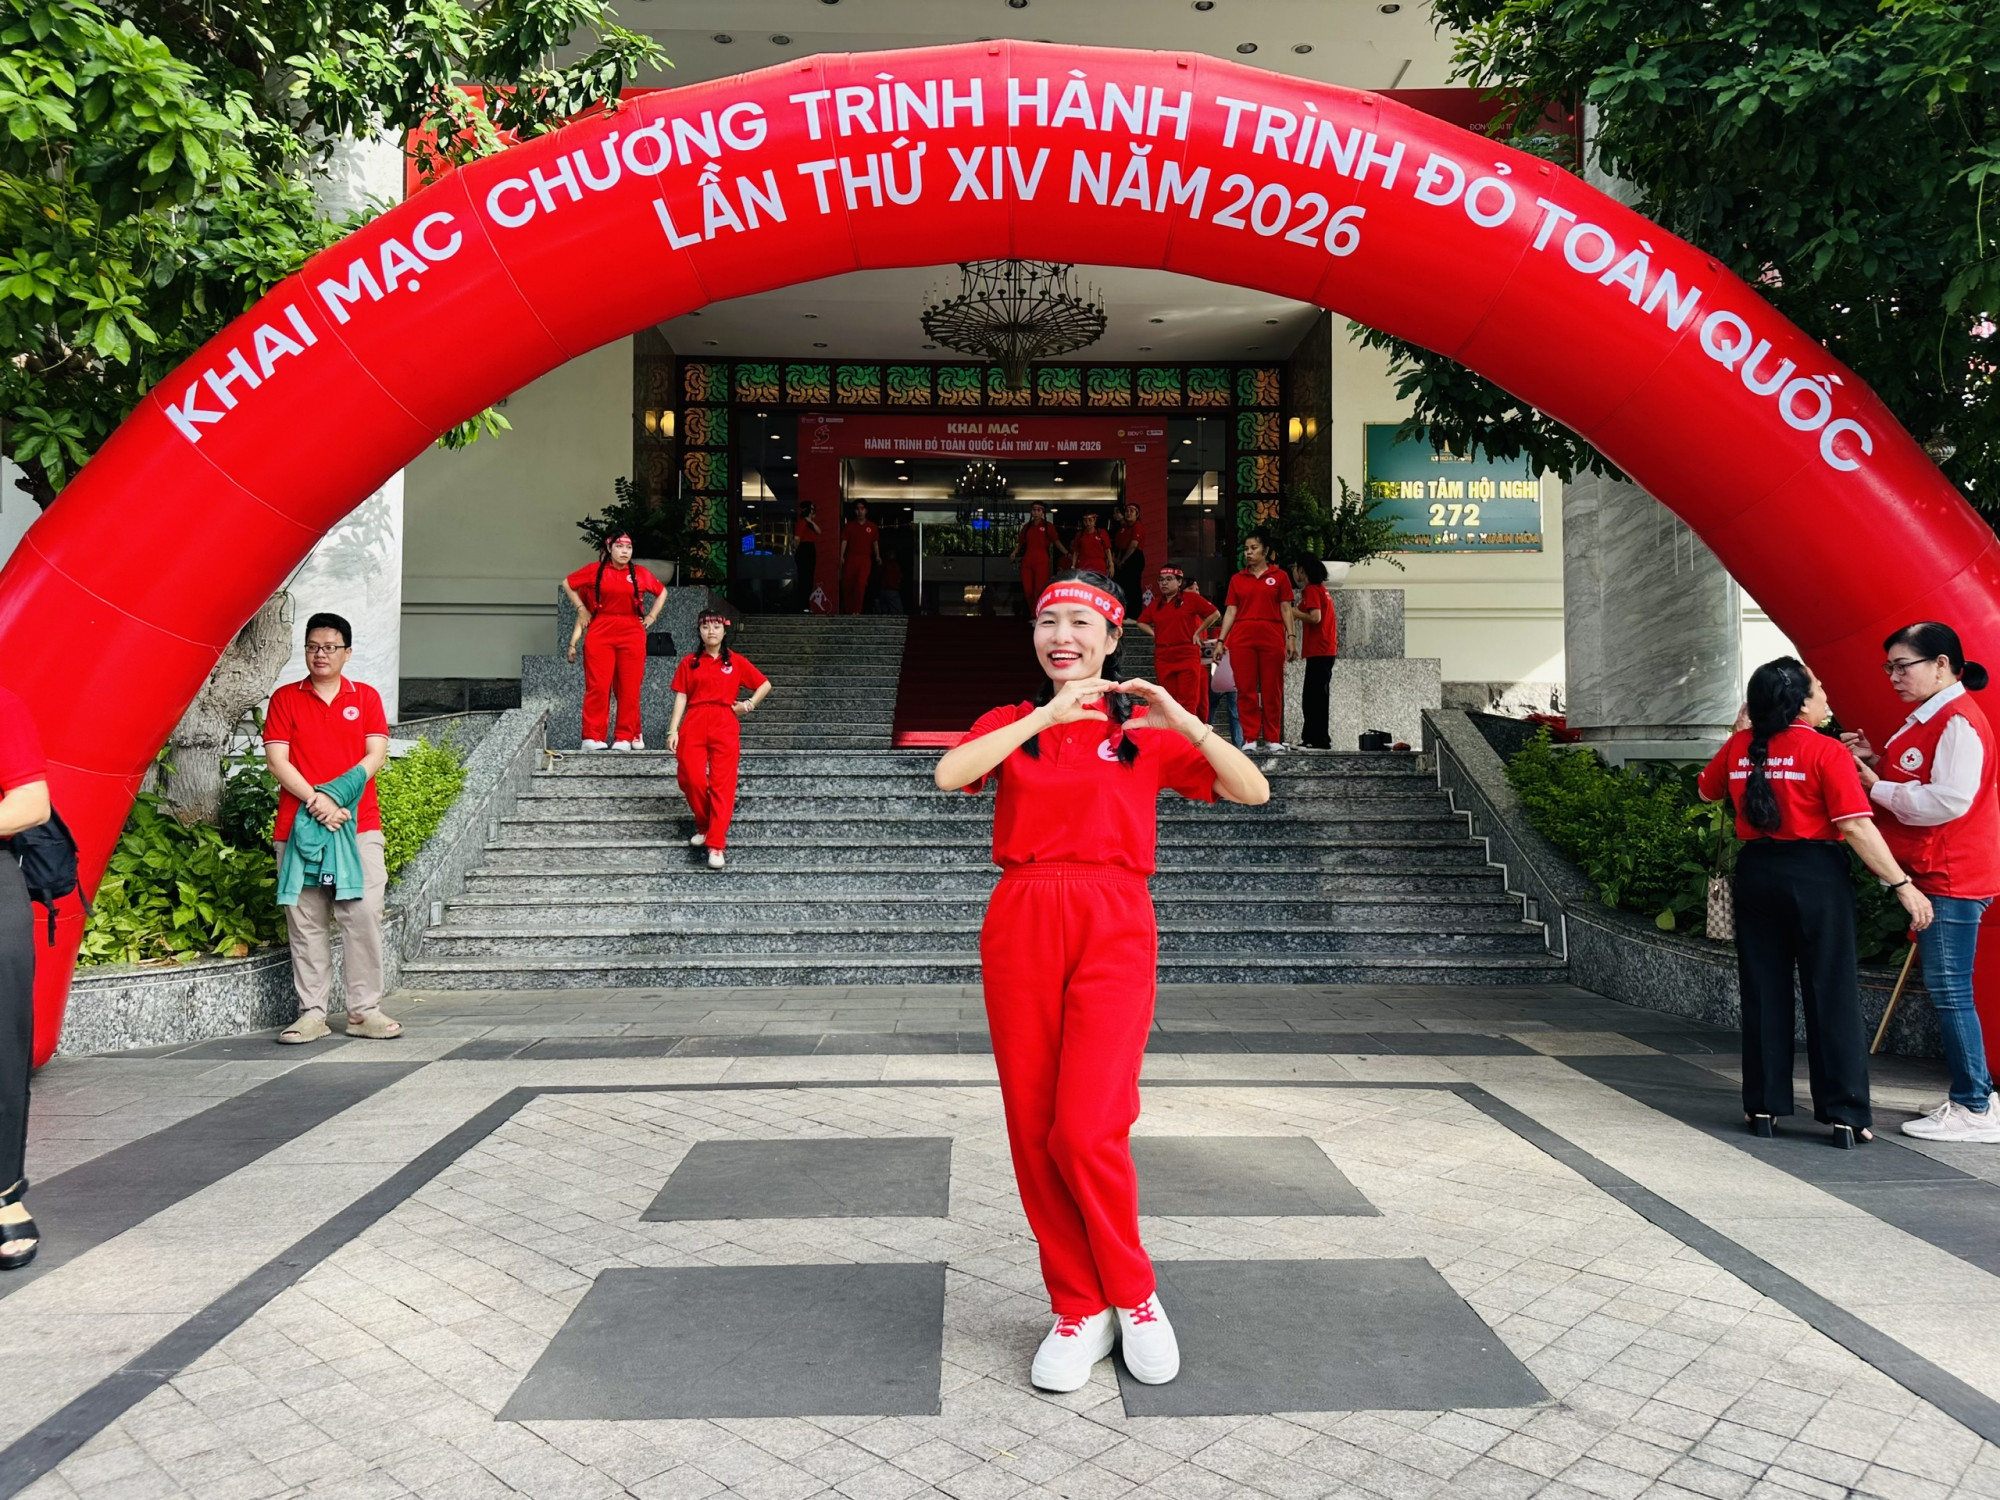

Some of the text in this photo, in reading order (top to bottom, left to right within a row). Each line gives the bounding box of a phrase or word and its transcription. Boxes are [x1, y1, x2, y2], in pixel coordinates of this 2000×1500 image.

[653, 136, 1366, 257] LẦN THỨ XIV NĂM 2026
[165, 69, 1873, 471] KHAI MẠC CHƯƠNG TRÌNH HÀNH TRÌNH ĐỎ TOÀN QUỐC
[947, 423, 1019, 437] KHAI MẠC
[864, 436, 891, 450] HÀNH
[894, 437, 922, 450] TRÌNH
[925, 436, 938, 450] ĐỎ
[941, 437, 966, 451] TOÀN
[968, 436, 994, 451] QUỐC
[1034, 440, 1049, 451] XIV
[1057, 439, 1078, 451] NĂM
[1080, 441, 1102, 451] 2026
[1428, 476, 1463, 499] TÂM
[1468, 476, 1495, 502] HỘI
[1499, 481, 1538, 502] NGHỊ
[1429, 503, 1480, 526] 272
[1054, 588, 1093, 602] TRÌNH
[1094, 596, 1111, 611] ĐỎ
